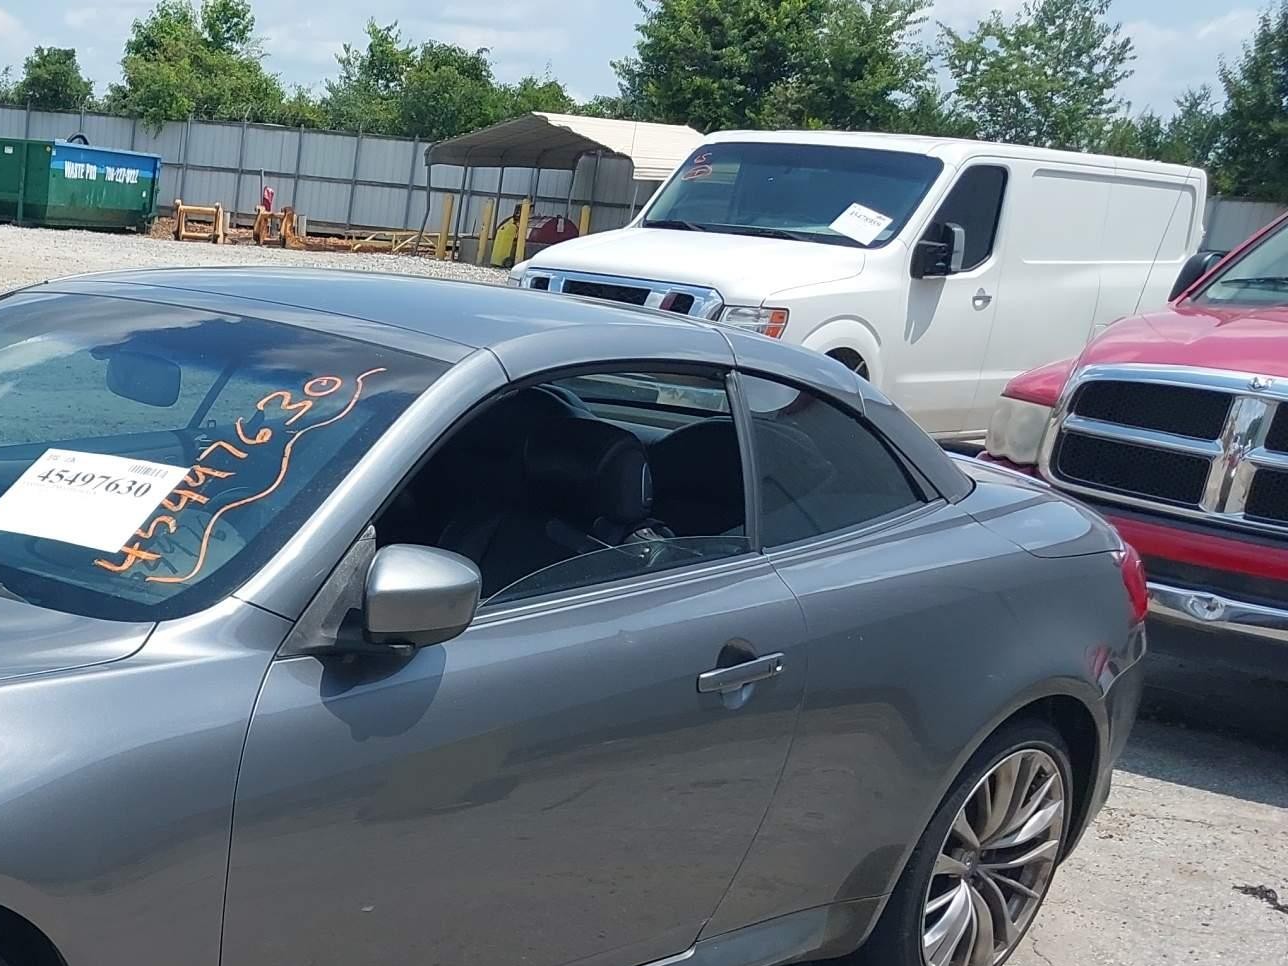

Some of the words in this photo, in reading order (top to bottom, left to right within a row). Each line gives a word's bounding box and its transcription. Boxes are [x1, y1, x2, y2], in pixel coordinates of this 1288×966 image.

[64, 160, 85, 179] WASTE
[86, 163, 97, 180] PRO
[37, 467, 152, 498] 45497630
